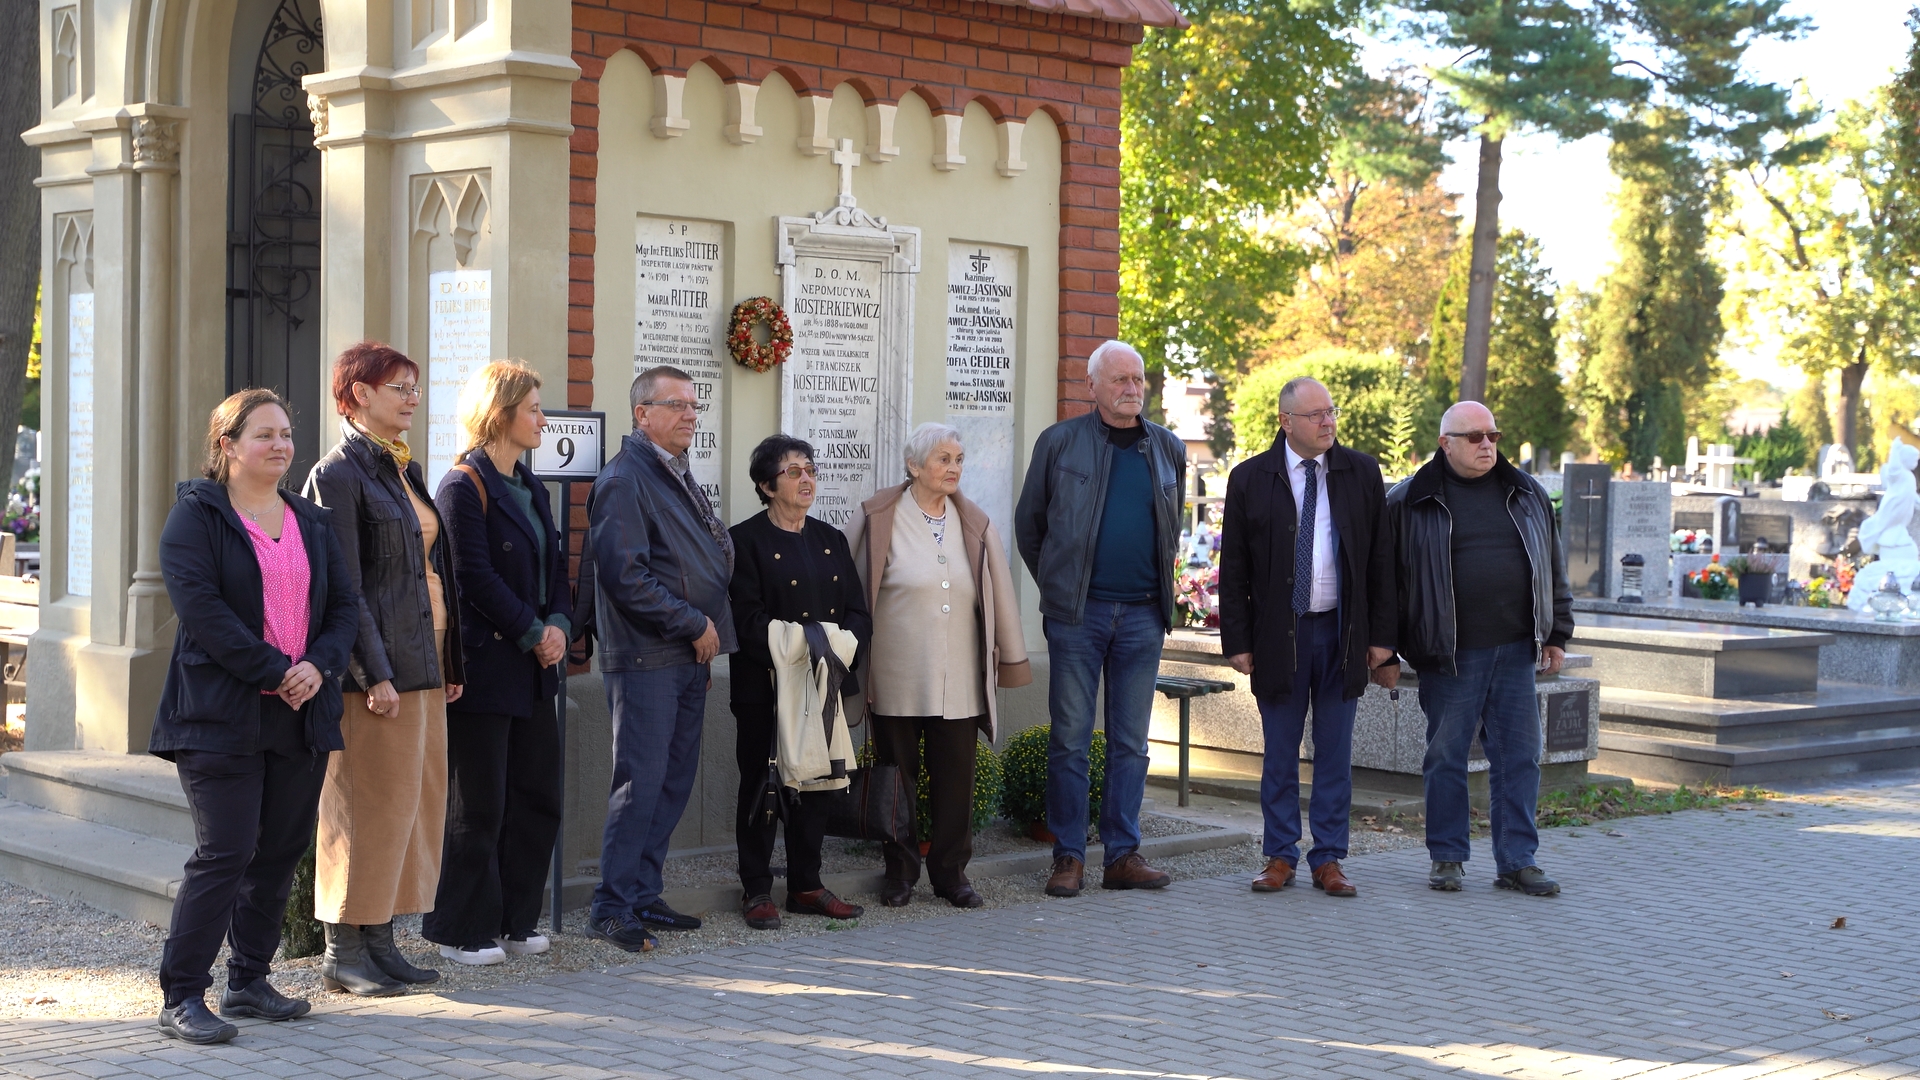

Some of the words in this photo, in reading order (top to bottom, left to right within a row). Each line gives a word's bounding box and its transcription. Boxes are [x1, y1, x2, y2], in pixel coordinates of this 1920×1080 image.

[660, 246, 684, 258] FELIKS
[685, 241, 719, 260] RITTER
[965, 272, 995, 283] Kazimierz
[801, 284, 871, 298] NEPOMUCYNA
[672, 289, 708, 308] RITTER
[794, 298, 880, 318] KOSTERKIEWICZ
[983, 306, 1000, 315] Maria
[816, 361, 861, 372] FRANCISZEK
[794, 374, 877, 392] KOSTERKIEWICZ
[972, 378, 1005, 388] STANISŁAW
[819, 429, 858, 439] STANISŁAW
[557, 437, 575, 468] 9
[695, 450, 711, 459] 2007
[824, 441, 870, 459] JASIŃSKI
[850, 474, 863, 482] 1927
[816, 494, 848, 505] RITTERÓW
